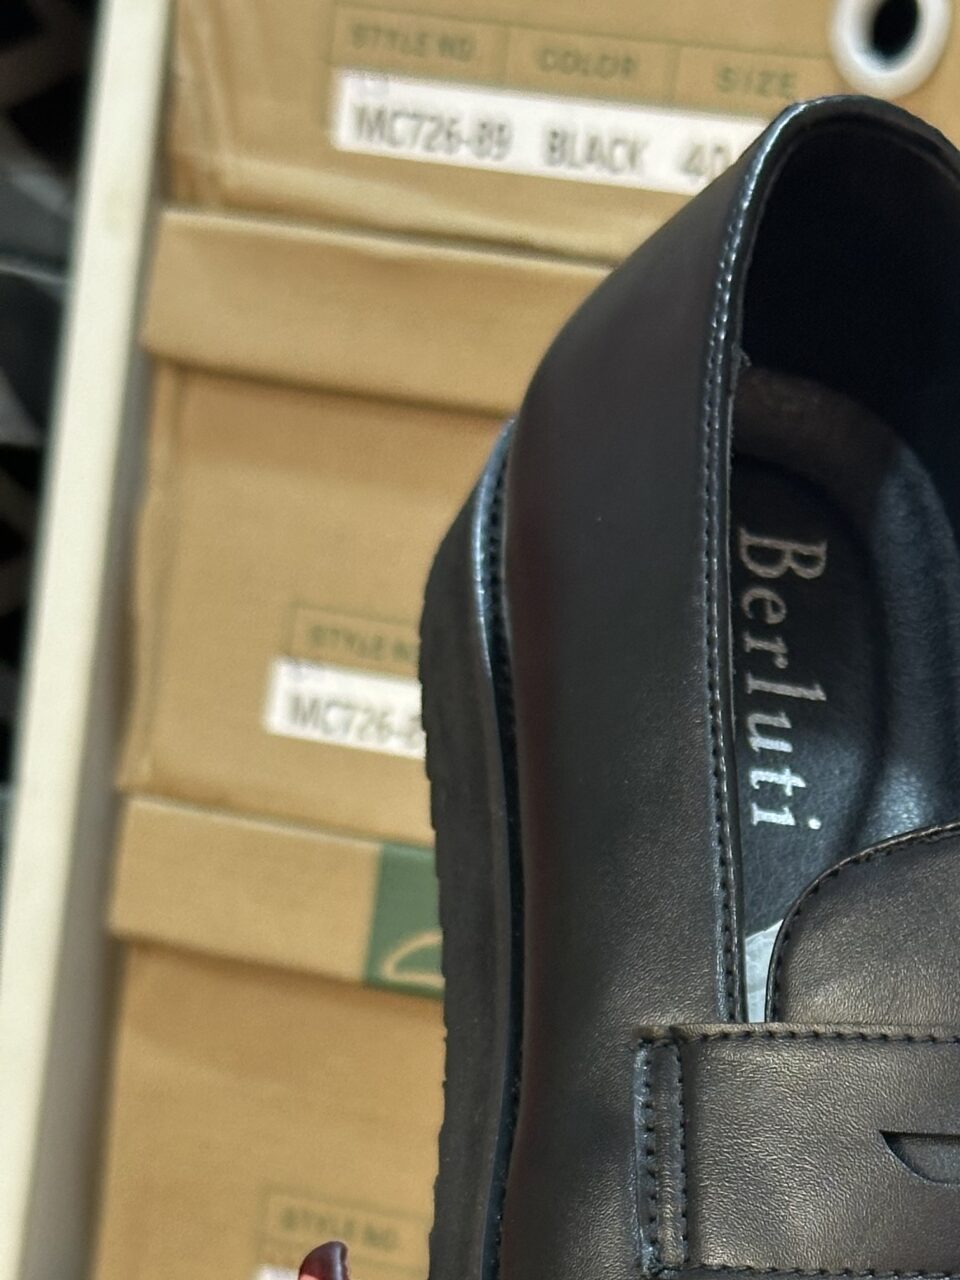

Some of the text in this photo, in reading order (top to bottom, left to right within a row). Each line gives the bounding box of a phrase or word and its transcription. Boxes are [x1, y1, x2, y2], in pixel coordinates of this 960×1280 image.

[350, 22, 427, 58] STYLE
[538, 48, 636, 76] COLOR
[716, 64, 798, 96] SIZE
[541, 126, 647, 173] BLACK
[738, 527, 828, 831] Berluti
